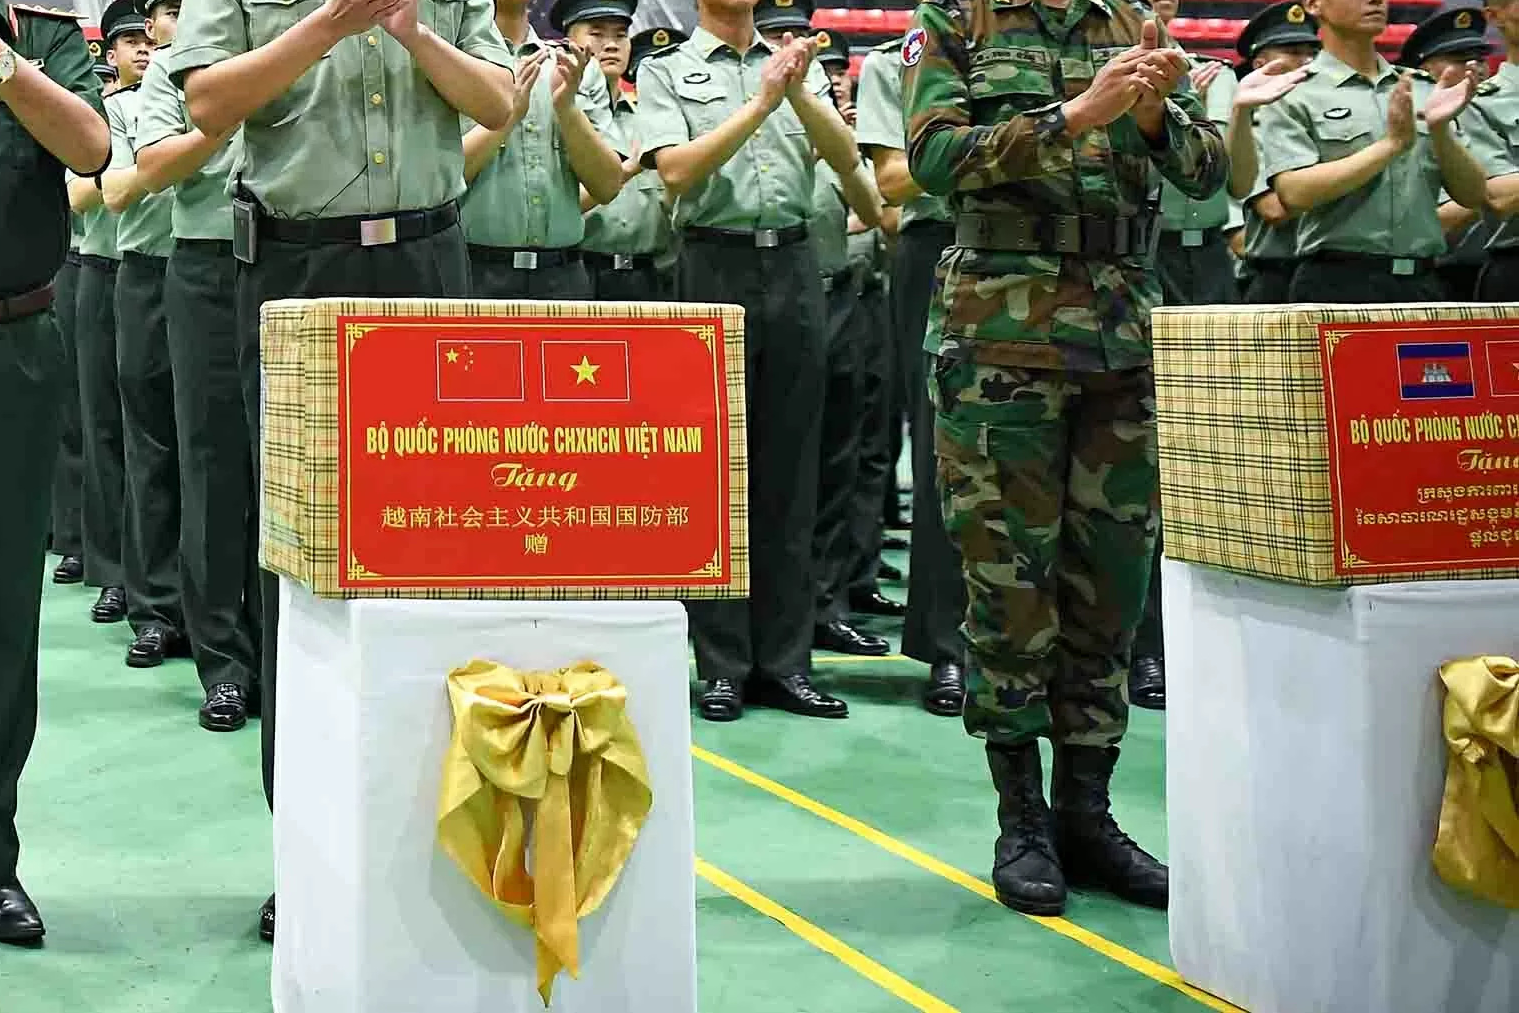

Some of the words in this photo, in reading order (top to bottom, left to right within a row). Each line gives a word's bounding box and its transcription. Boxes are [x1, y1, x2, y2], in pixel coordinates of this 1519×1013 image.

[366, 420, 389, 460] BỘ
[393, 416, 439, 457] QUỐC
[443, 420, 500, 454] PHÒNG
[504, 420, 549, 454] NƯỚC
[554, 426, 621, 454] CHXHCN
[624, 420, 658, 460] VIỆT
[663, 426, 702, 454] NAM
[1350, 414, 1370, 449] BỘ
[1373, 408, 1411, 446] QUỐC
[1414, 411, 1462, 442] PHÒNG
[1464, 409, 1504, 441] NƯỚC
[490, 462, 578, 492] Tặng
[380, 504, 690, 529] 越南社会主义共和国国防部
[524, 531, 549, 556] 赠
